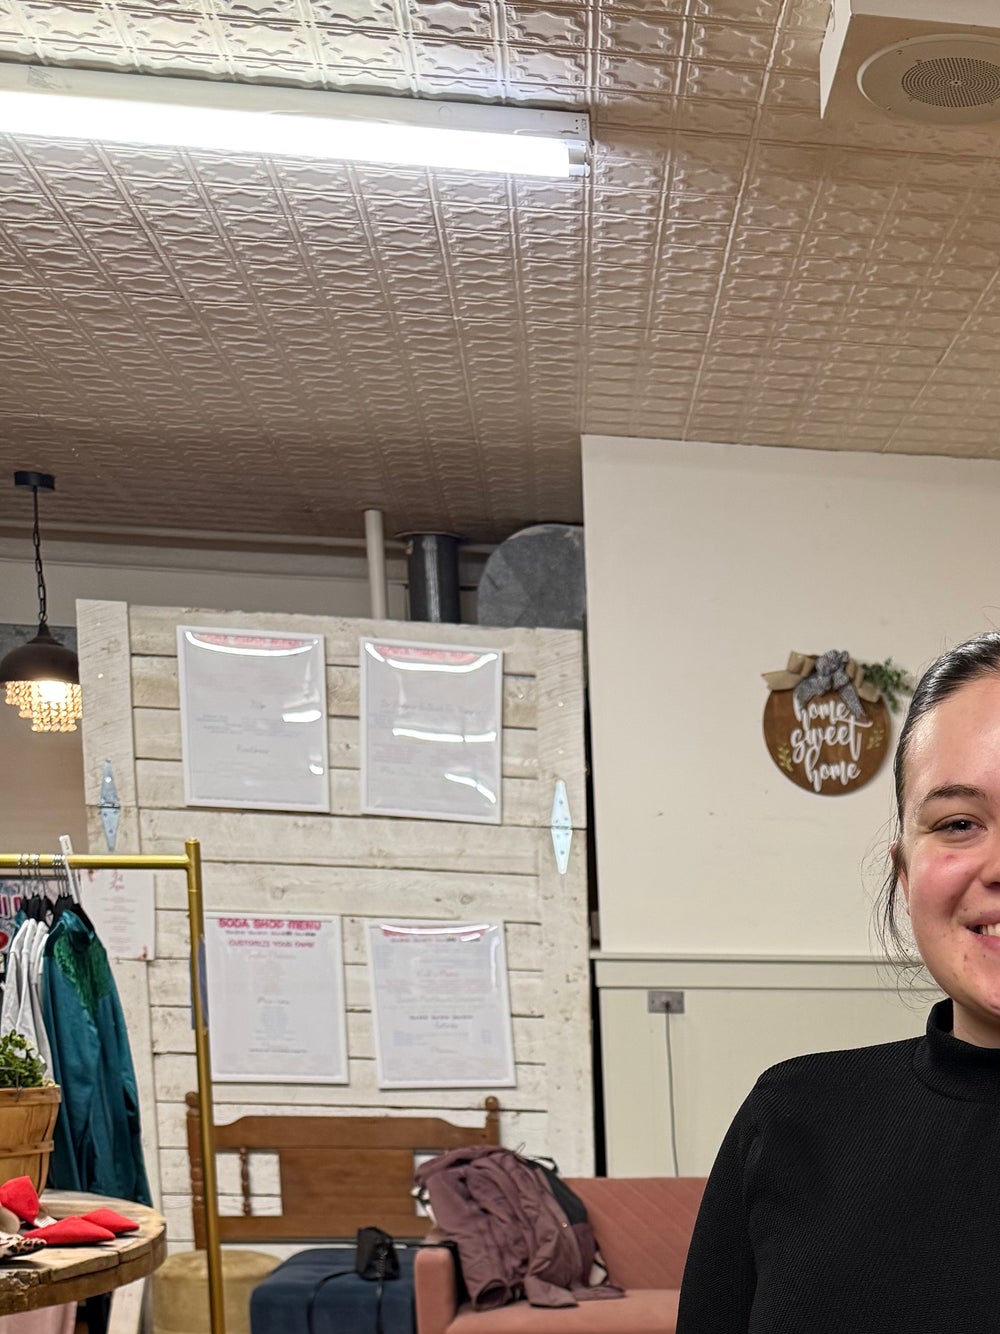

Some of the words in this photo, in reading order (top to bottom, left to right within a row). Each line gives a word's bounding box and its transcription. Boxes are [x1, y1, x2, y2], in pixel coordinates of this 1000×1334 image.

[793, 690, 851, 731] home
[791, 716, 868, 763] sweet
[805, 747, 861, 792] home
[218, 918, 249, 928] SODA
[253, 918, 284, 929] SHOP
[287, 920, 321, 930] MENU
